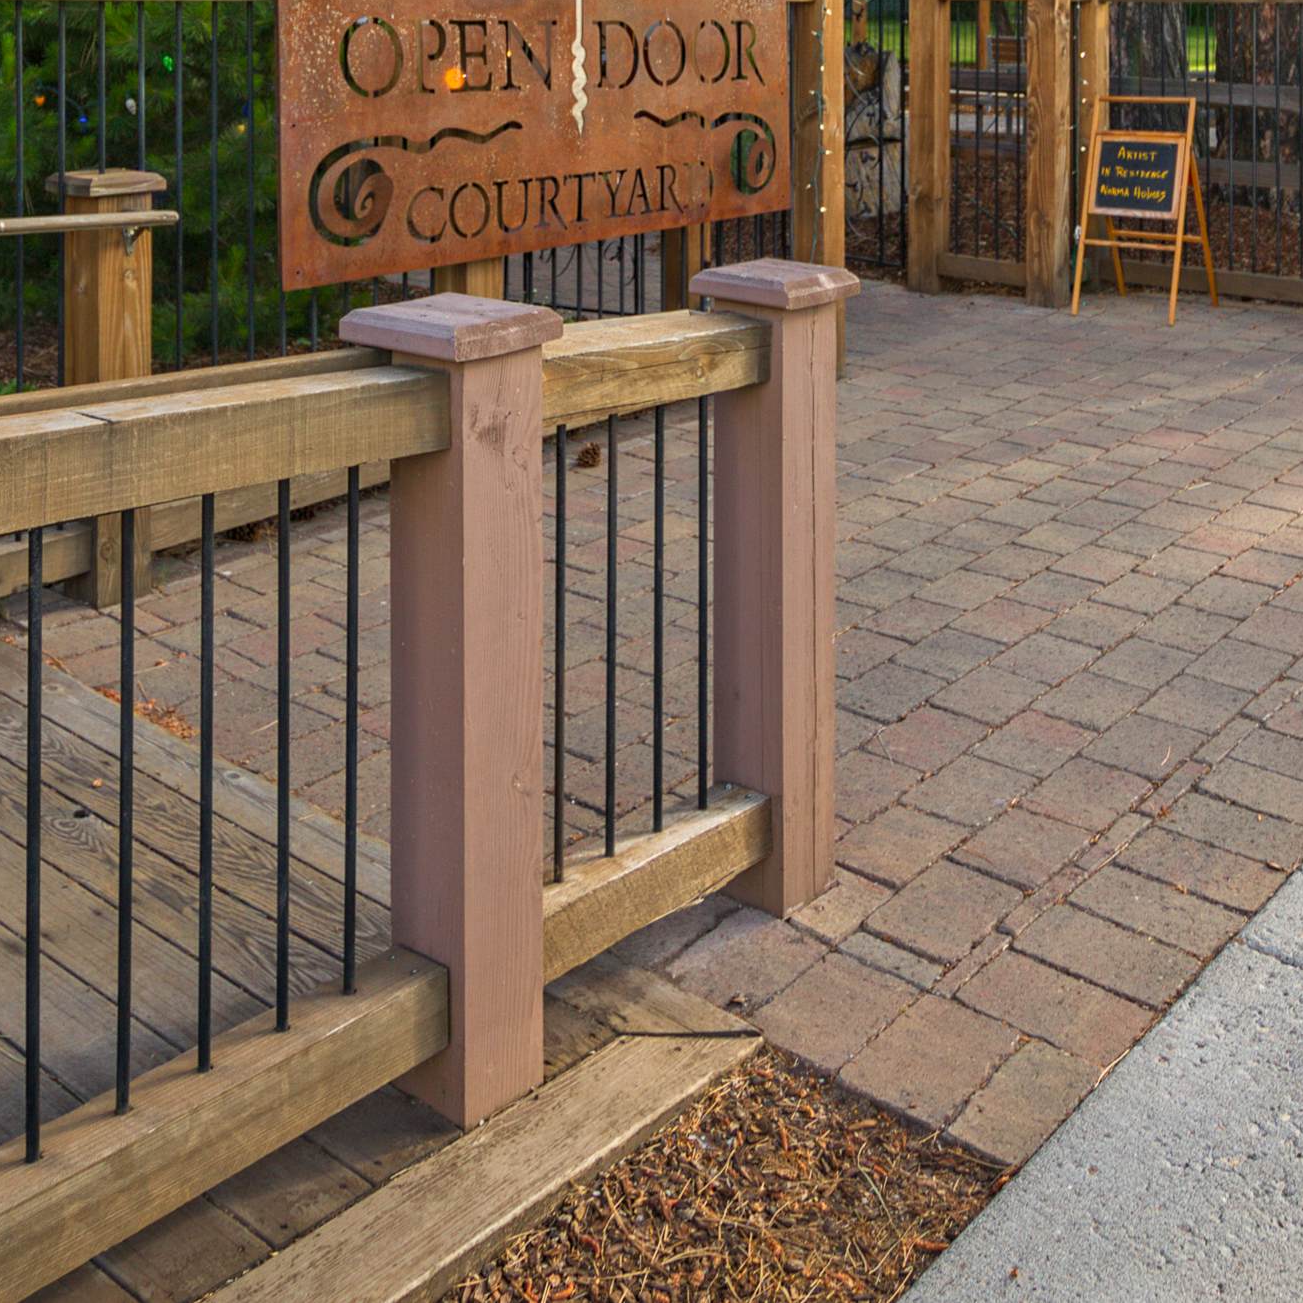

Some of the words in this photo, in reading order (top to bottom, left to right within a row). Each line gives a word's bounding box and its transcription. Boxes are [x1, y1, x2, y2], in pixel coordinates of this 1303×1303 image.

[339, 16, 559, 98] OPEN
[592, 18, 767, 90] DOOR
[406, 159, 715, 244] COURTYARD
